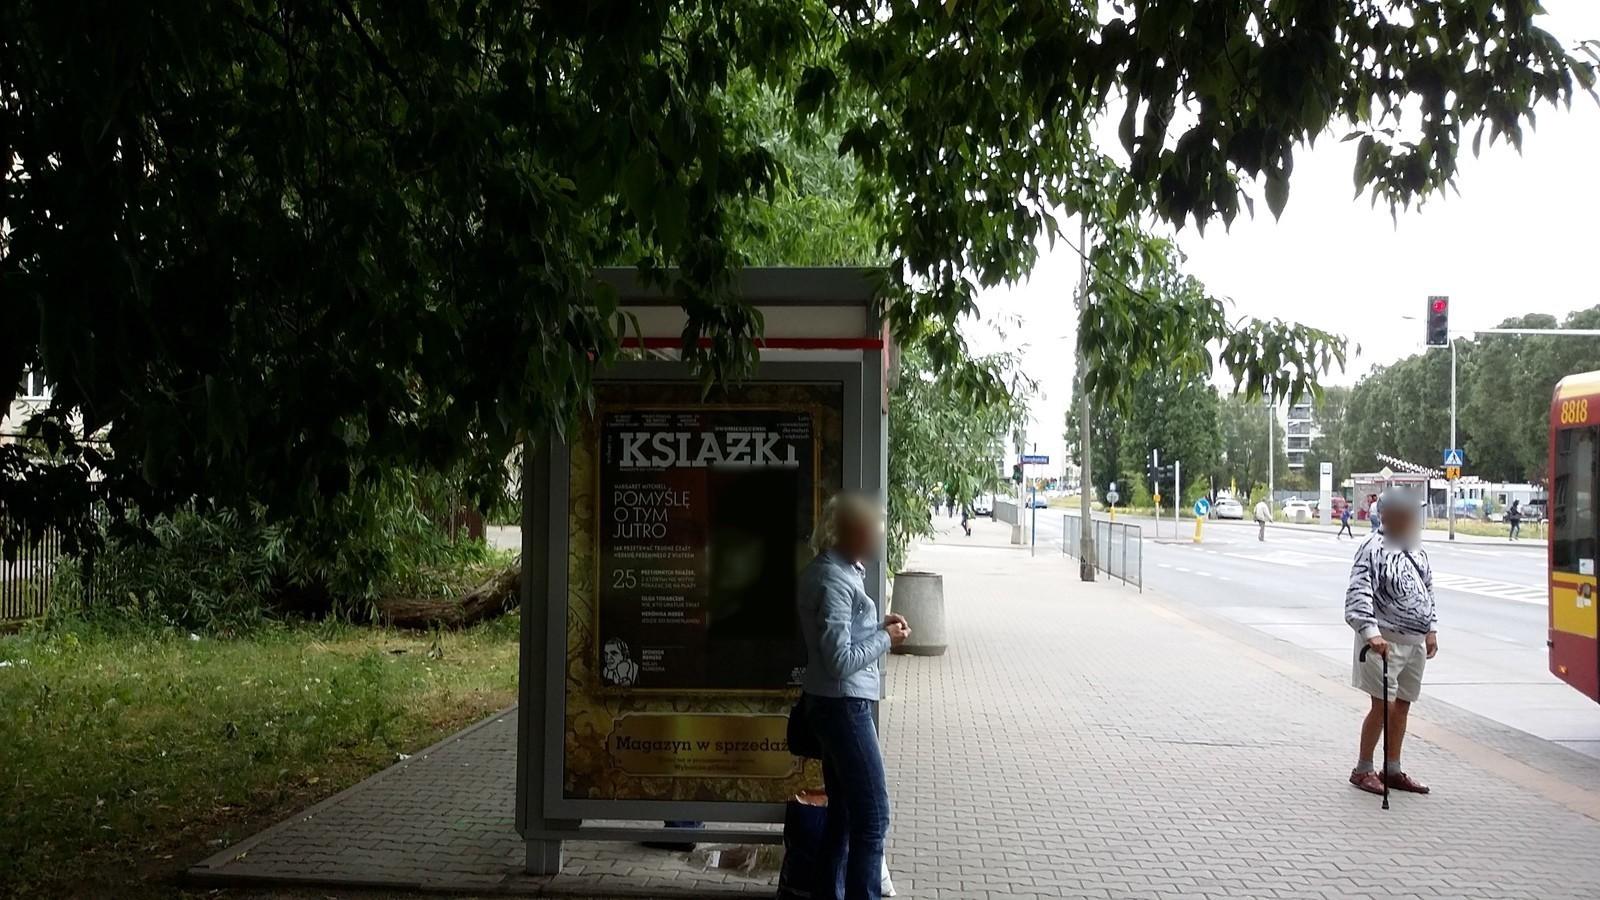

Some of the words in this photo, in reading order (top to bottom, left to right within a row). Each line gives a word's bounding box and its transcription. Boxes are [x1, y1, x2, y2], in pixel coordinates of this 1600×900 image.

[1561, 399, 1588, 424] 8818
[614, 488, 690, 509] POMYŚLĘ
[614, 507, 629, 522] O
[633, 507, 668, 522] TYM
[612, 523, 666, 539] JUTRO
[612, 569, 637, 589] 25
[616, 736, 691, 754] Magazyn
[697, 741, 710, 750] w
[715, 738, 790, 754] sprzedaż
